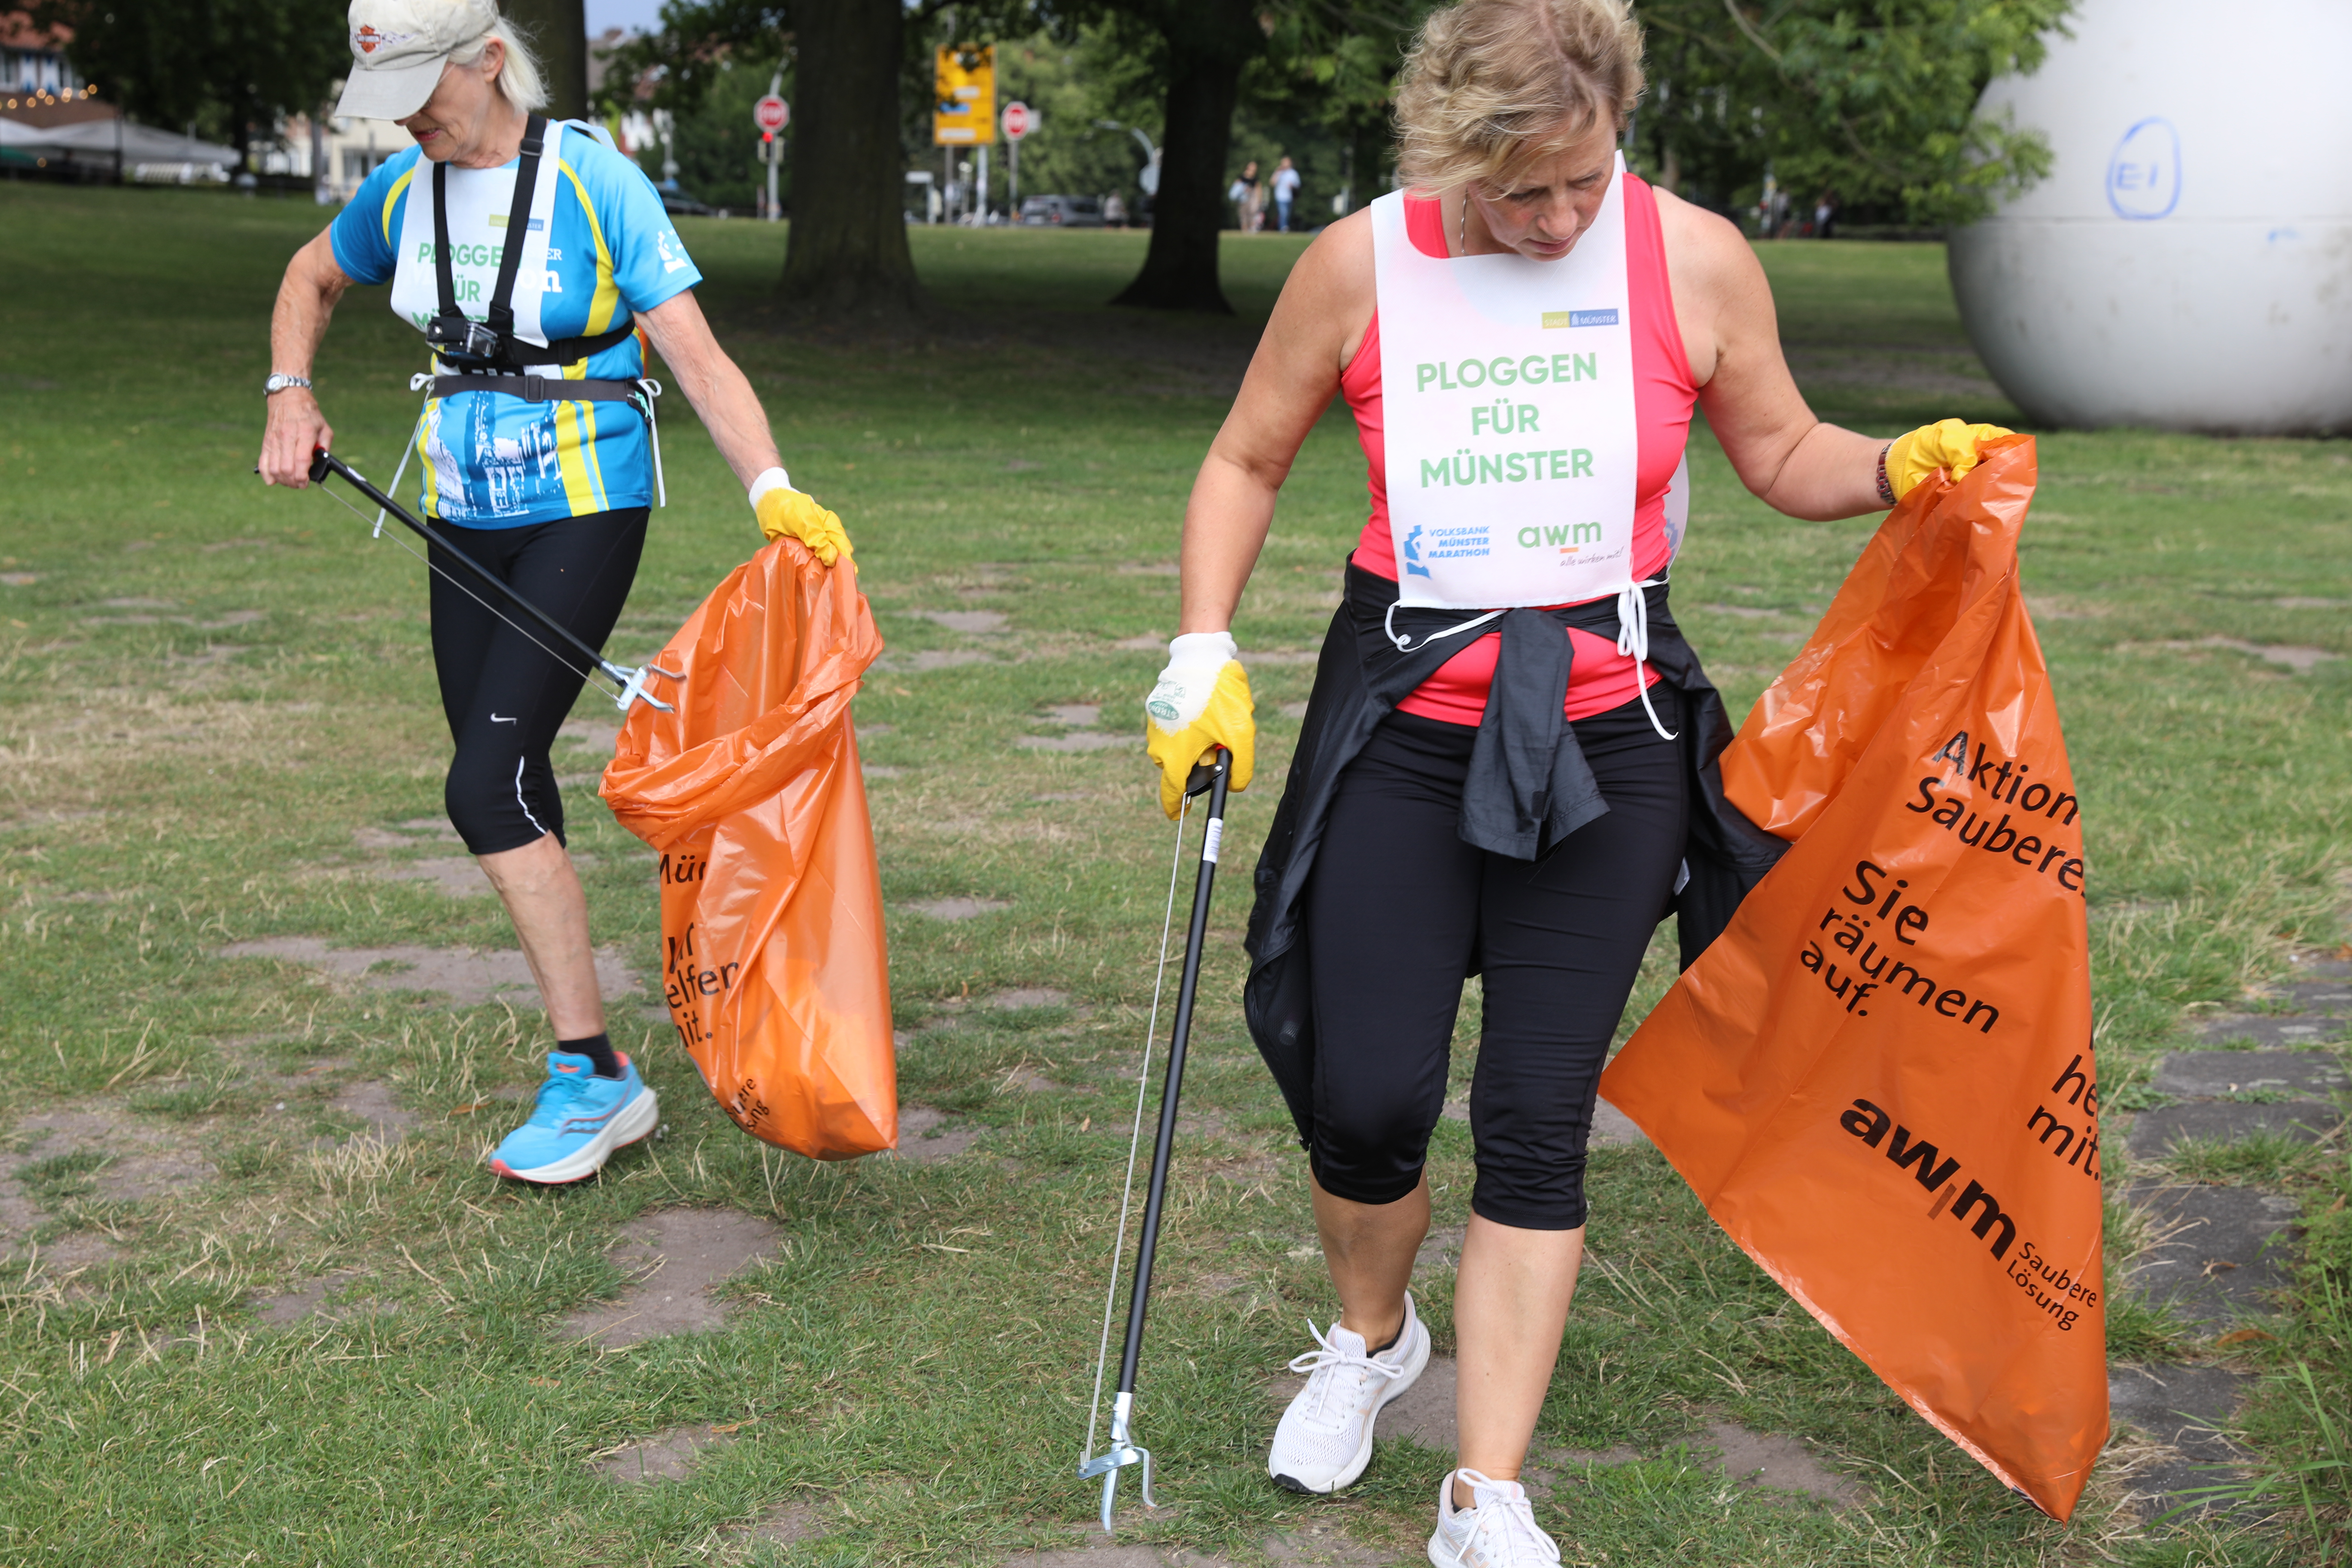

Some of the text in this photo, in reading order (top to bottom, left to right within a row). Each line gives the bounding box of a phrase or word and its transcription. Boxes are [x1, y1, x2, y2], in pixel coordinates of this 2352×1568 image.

[453, 275, 480, 302] ÜR
[1580, 314, 1617, 325] MÜNSTER
[1416, 352, 1597, 392] PLOGGEN
[1471, 398, 1540, 436] FÜR
[1420, 449, 1594, 488] MÜNSTER
[1429, 525, 1490, 537] VOLKSBANK
[1439, 537, 1489, 548] MÜNSTER
[1518, 521, 1602, 548] awm
[1428, 548, 1490, 558] MARATHON
[1560, 555, 1576, 567] alle
[1578, 553, 1605, 565] wirken
[1932, 730, 2078, 826] Aktion
[1906, 776, 2085, 898] Saubere
[1842, 860, 1929, 946] Sie
[1800, 941, 1879, 1017] auf.
[1819, 907, 2000, 1034] räumen
[2027, 1105, 2099, 1181] mit.
[2018, 1241, 2098, 1308] Saubere
[2006, 1259, 2080, 1331] Lösung
